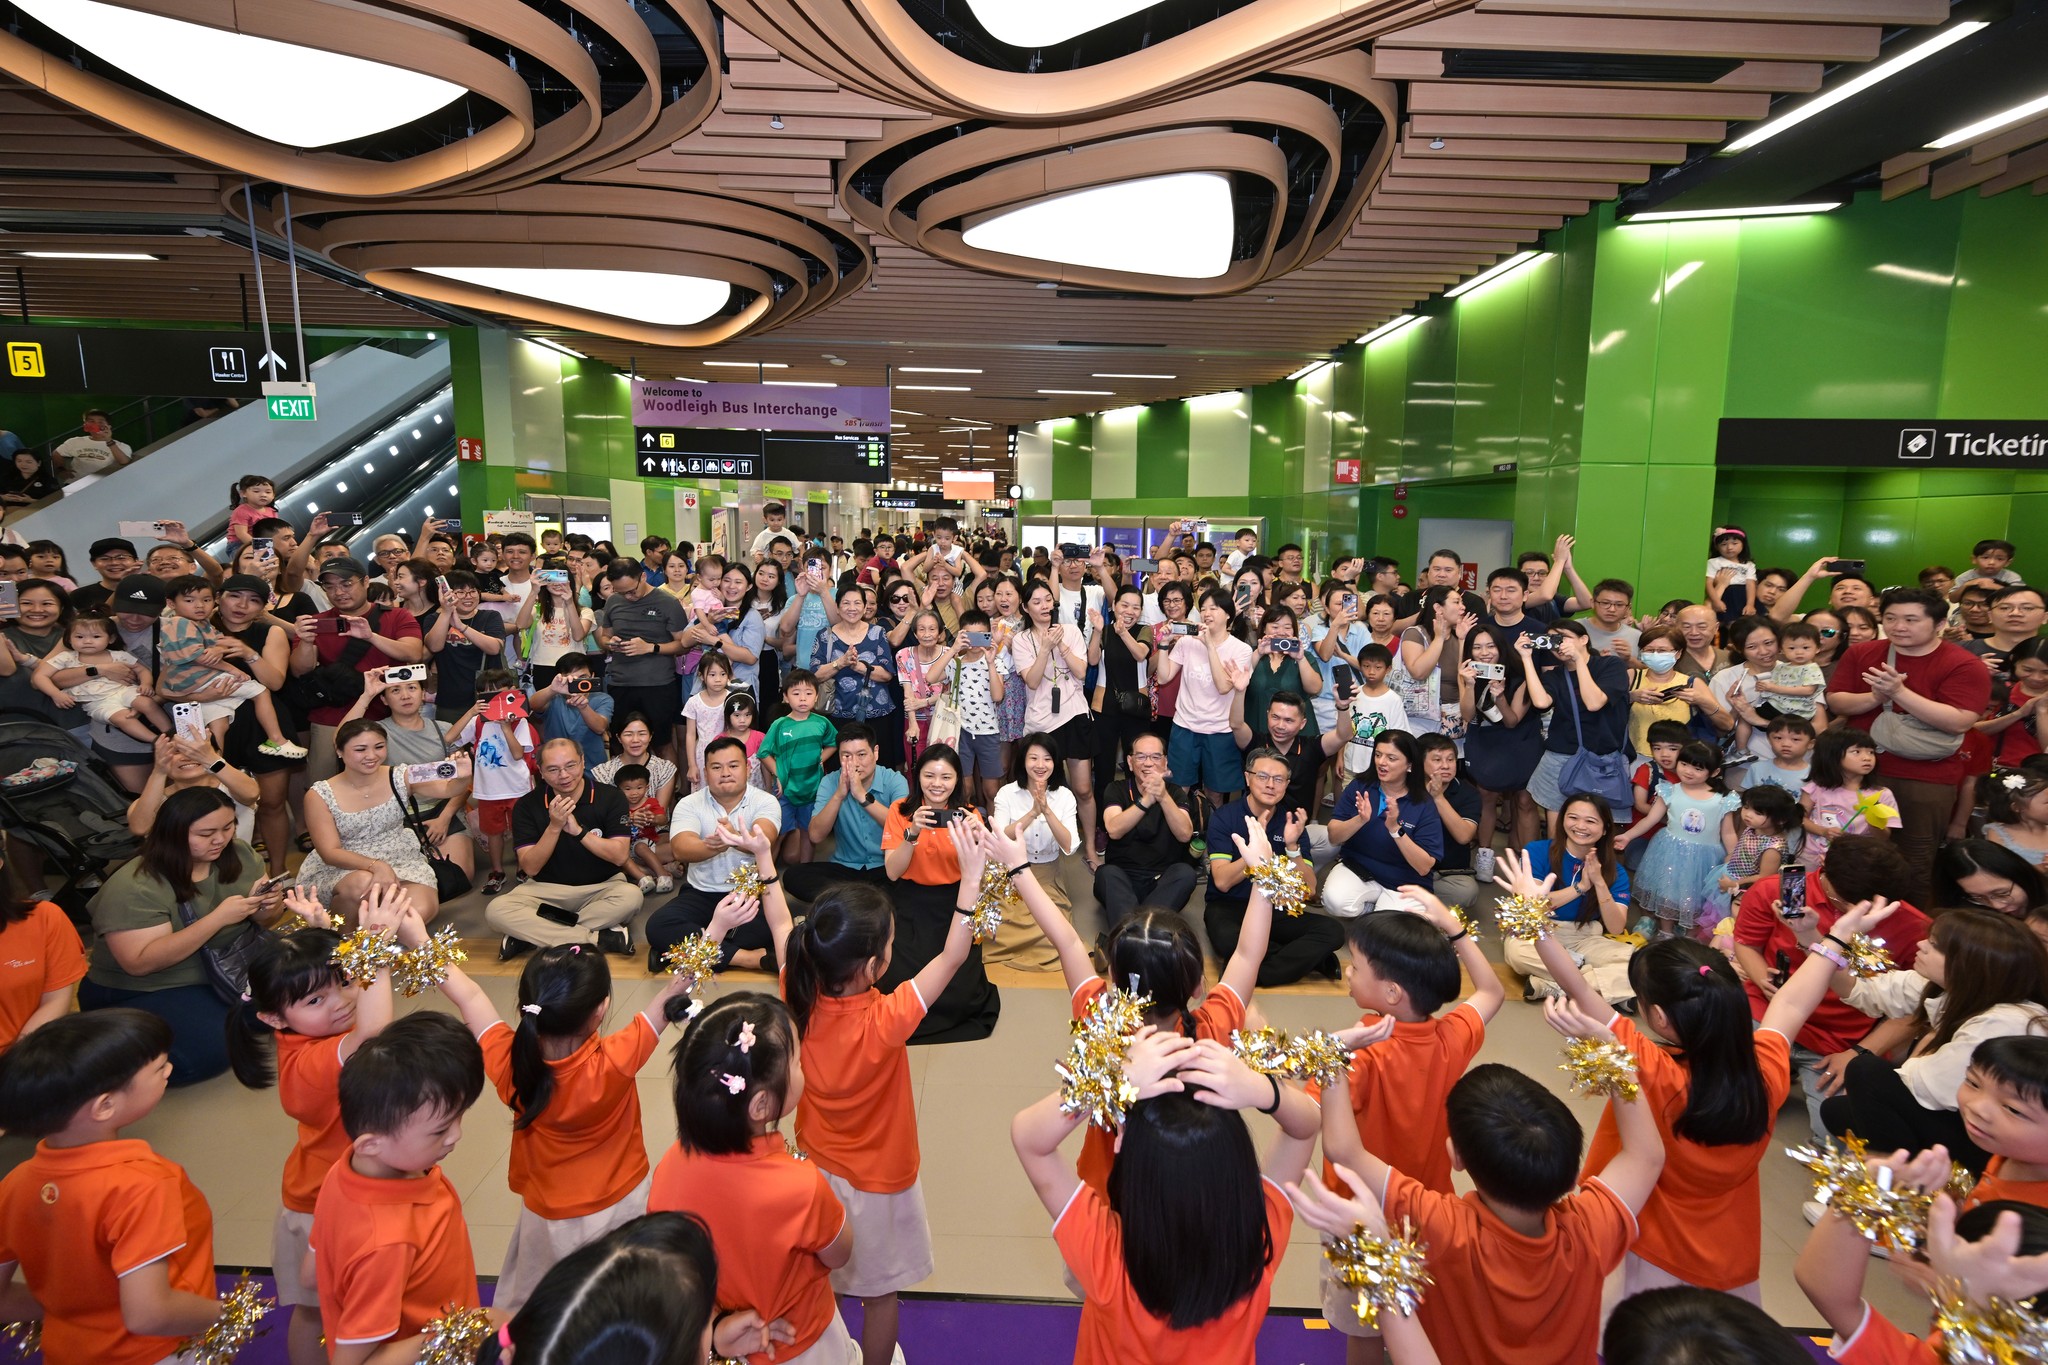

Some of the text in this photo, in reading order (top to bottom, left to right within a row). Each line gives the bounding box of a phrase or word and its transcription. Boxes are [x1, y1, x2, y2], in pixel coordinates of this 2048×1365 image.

[22, 355, 32, 371] 5
[642, 387, 702, 398] Welcome to
[279, 399, 310, 417] EXIT
[643, 399, 838, 419] Woodleigh Bus Interchange
[844, 417, 884, 427] SBS Transit
